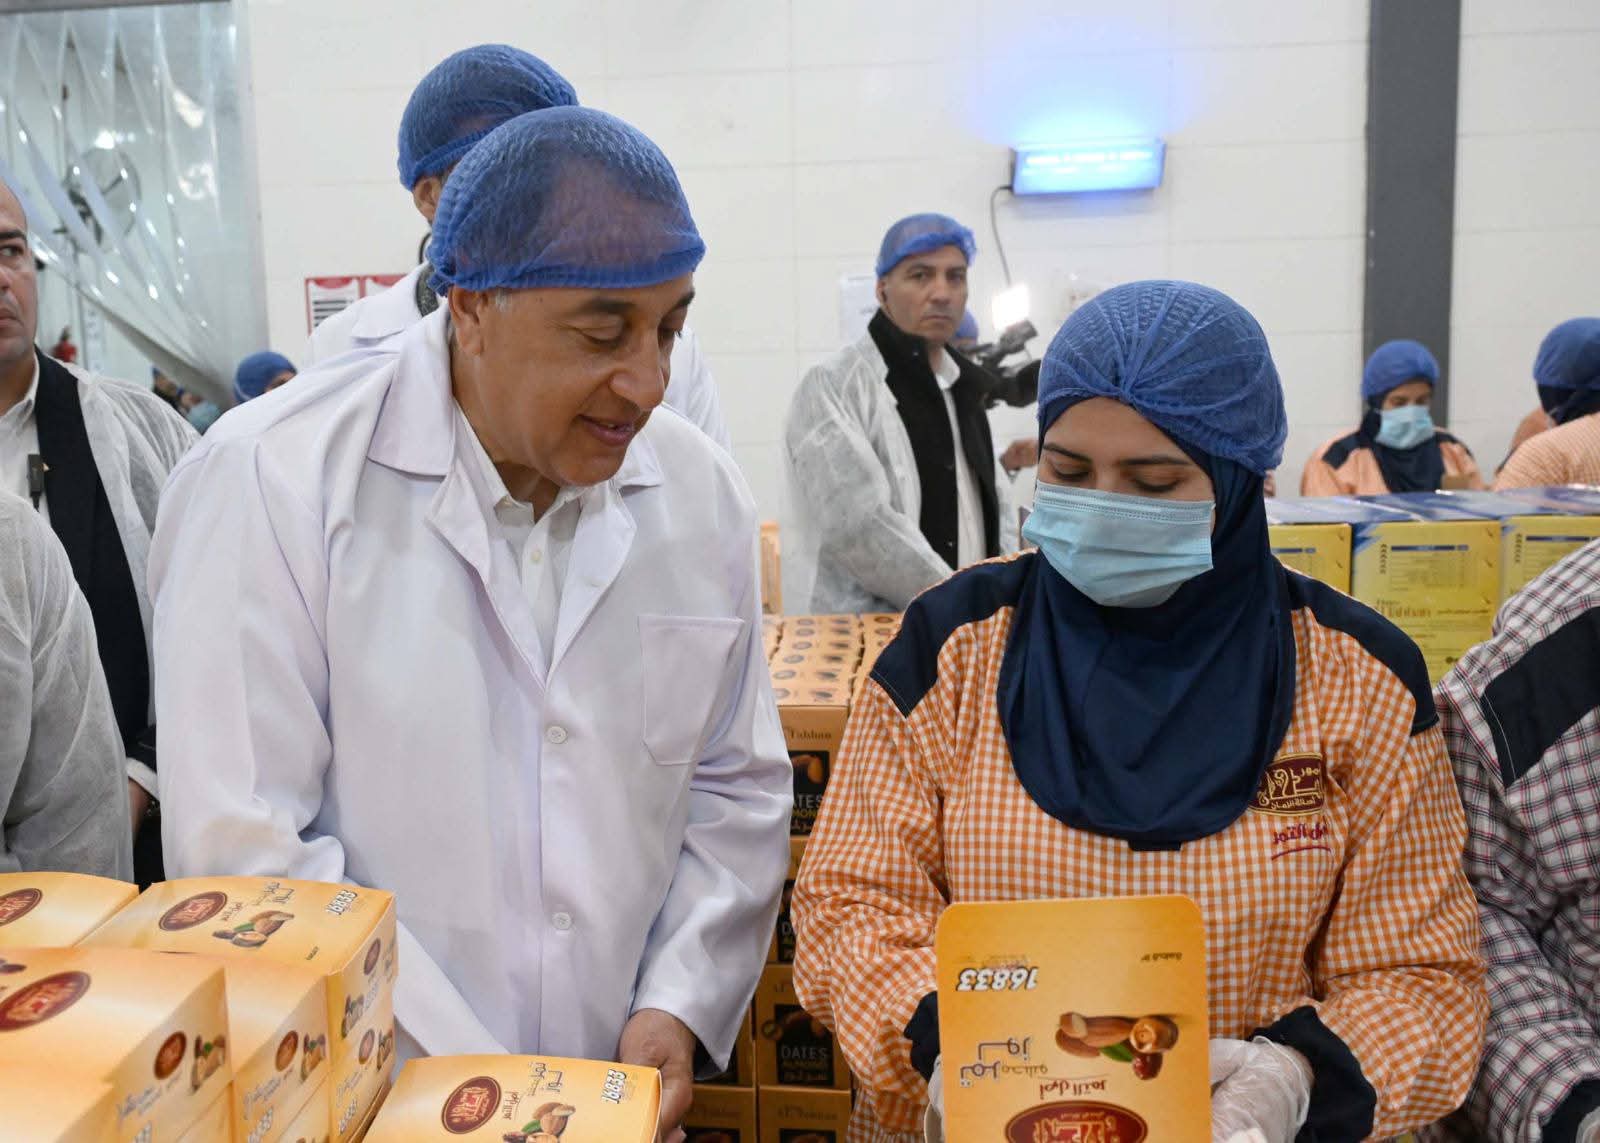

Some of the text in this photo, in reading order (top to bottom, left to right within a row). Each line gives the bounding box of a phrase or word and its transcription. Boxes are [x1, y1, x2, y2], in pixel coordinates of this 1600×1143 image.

[956, 965, 1040, 993] 16833
[600, 1068, 628, 1105] 16833
[1073, 1079, 1108, 1097] التمر
